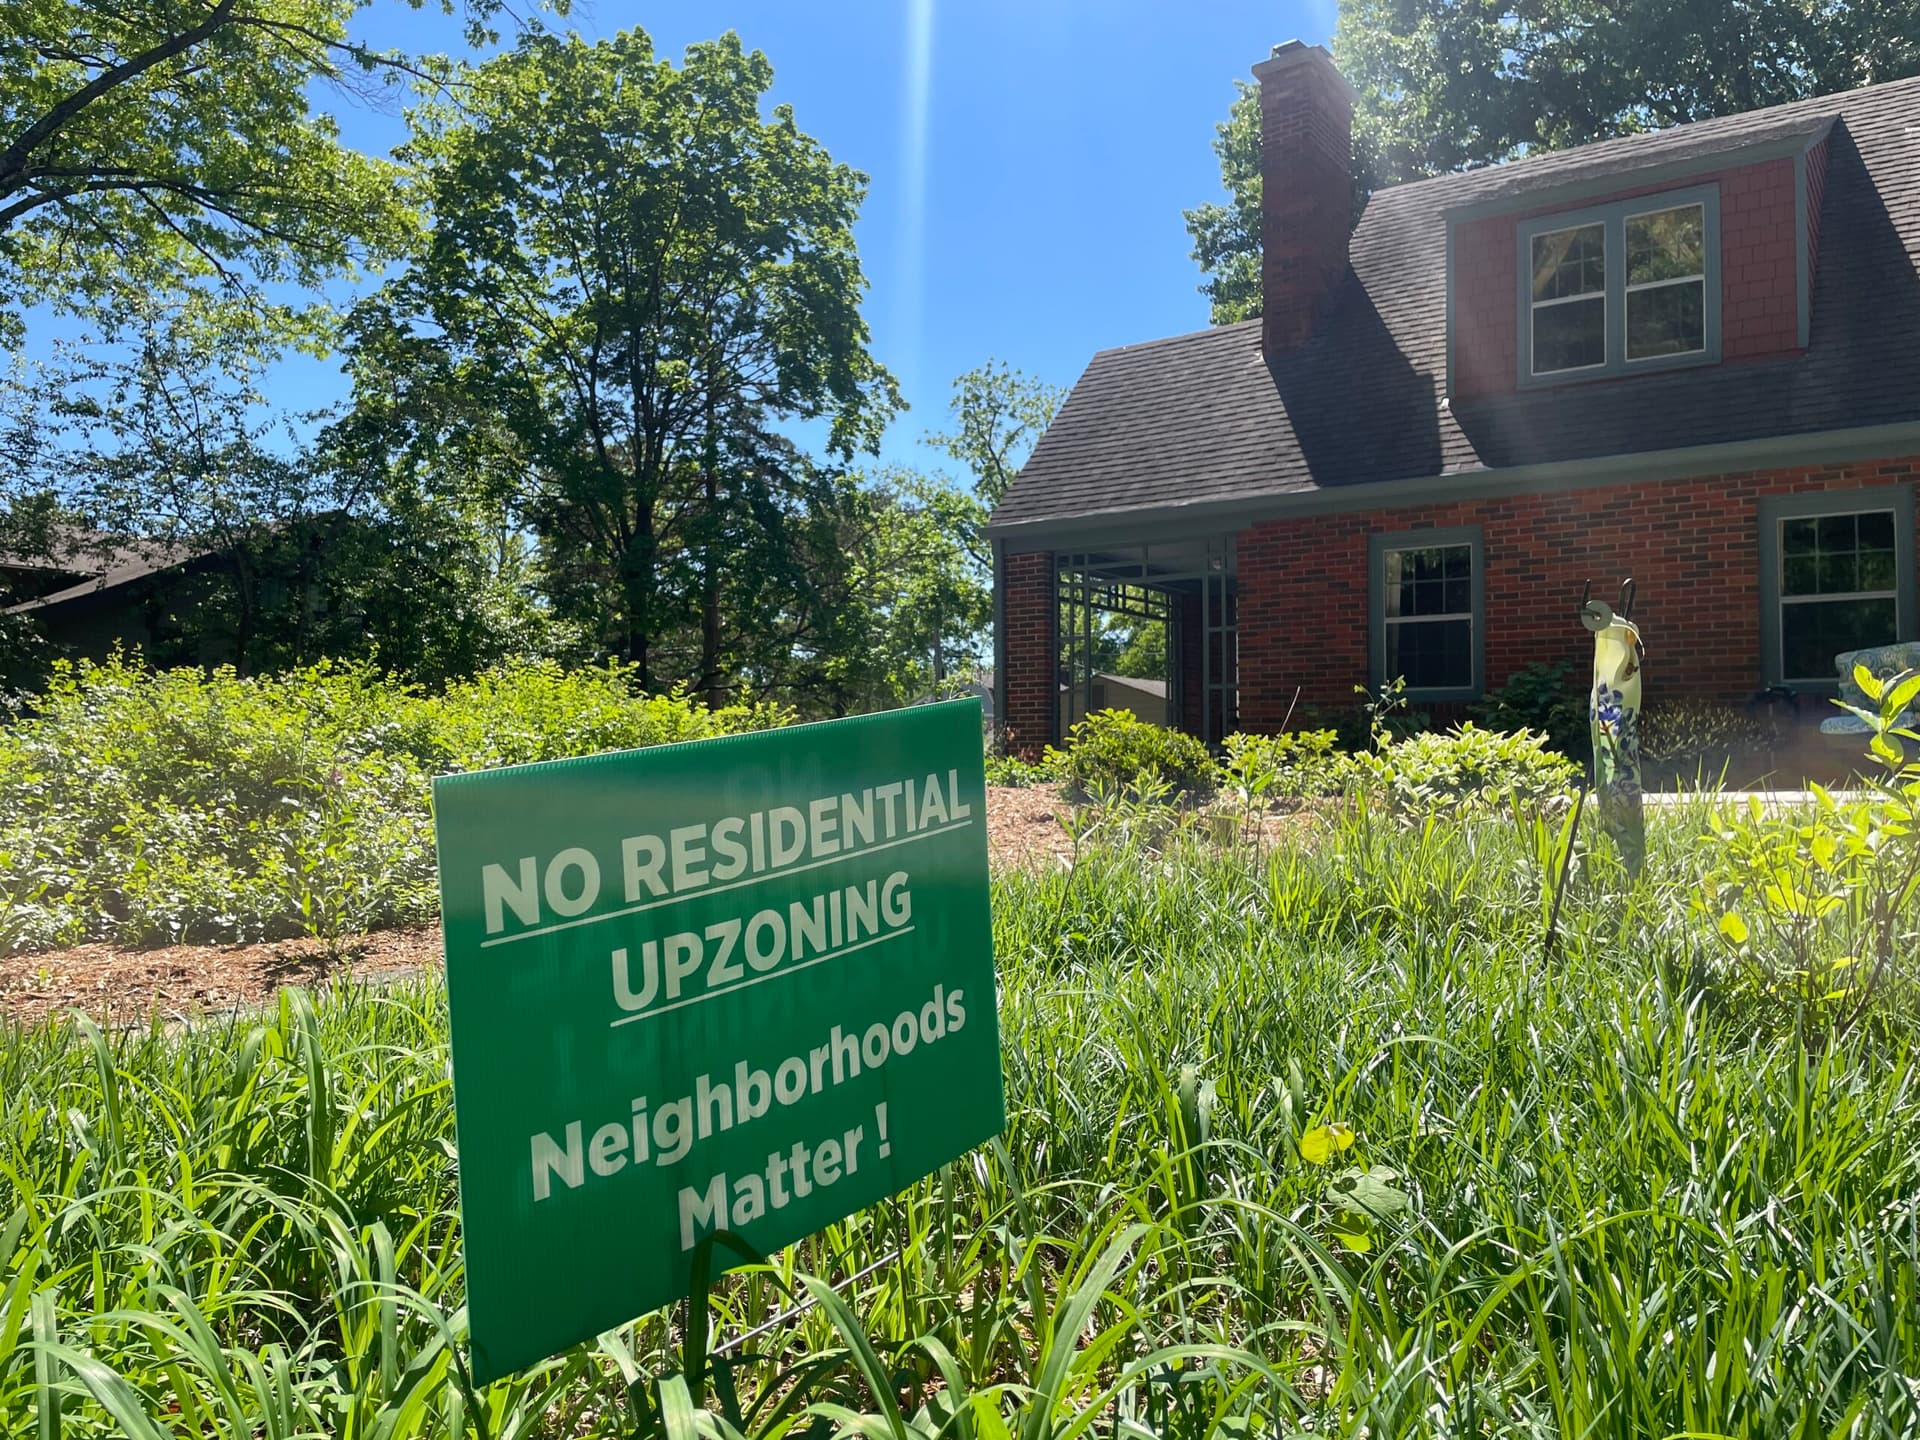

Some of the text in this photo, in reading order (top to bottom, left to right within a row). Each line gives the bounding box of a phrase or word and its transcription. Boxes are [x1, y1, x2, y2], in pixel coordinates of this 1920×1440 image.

[481, 847, 601, 934] NO
[621, 769, 971, 903] RESIDENTIAL
[611, 871, 912, 1012] UPZONING
[530, 983, 967, 1202] Neighborhoods
[677, 1125, 864, 1252] Matter
